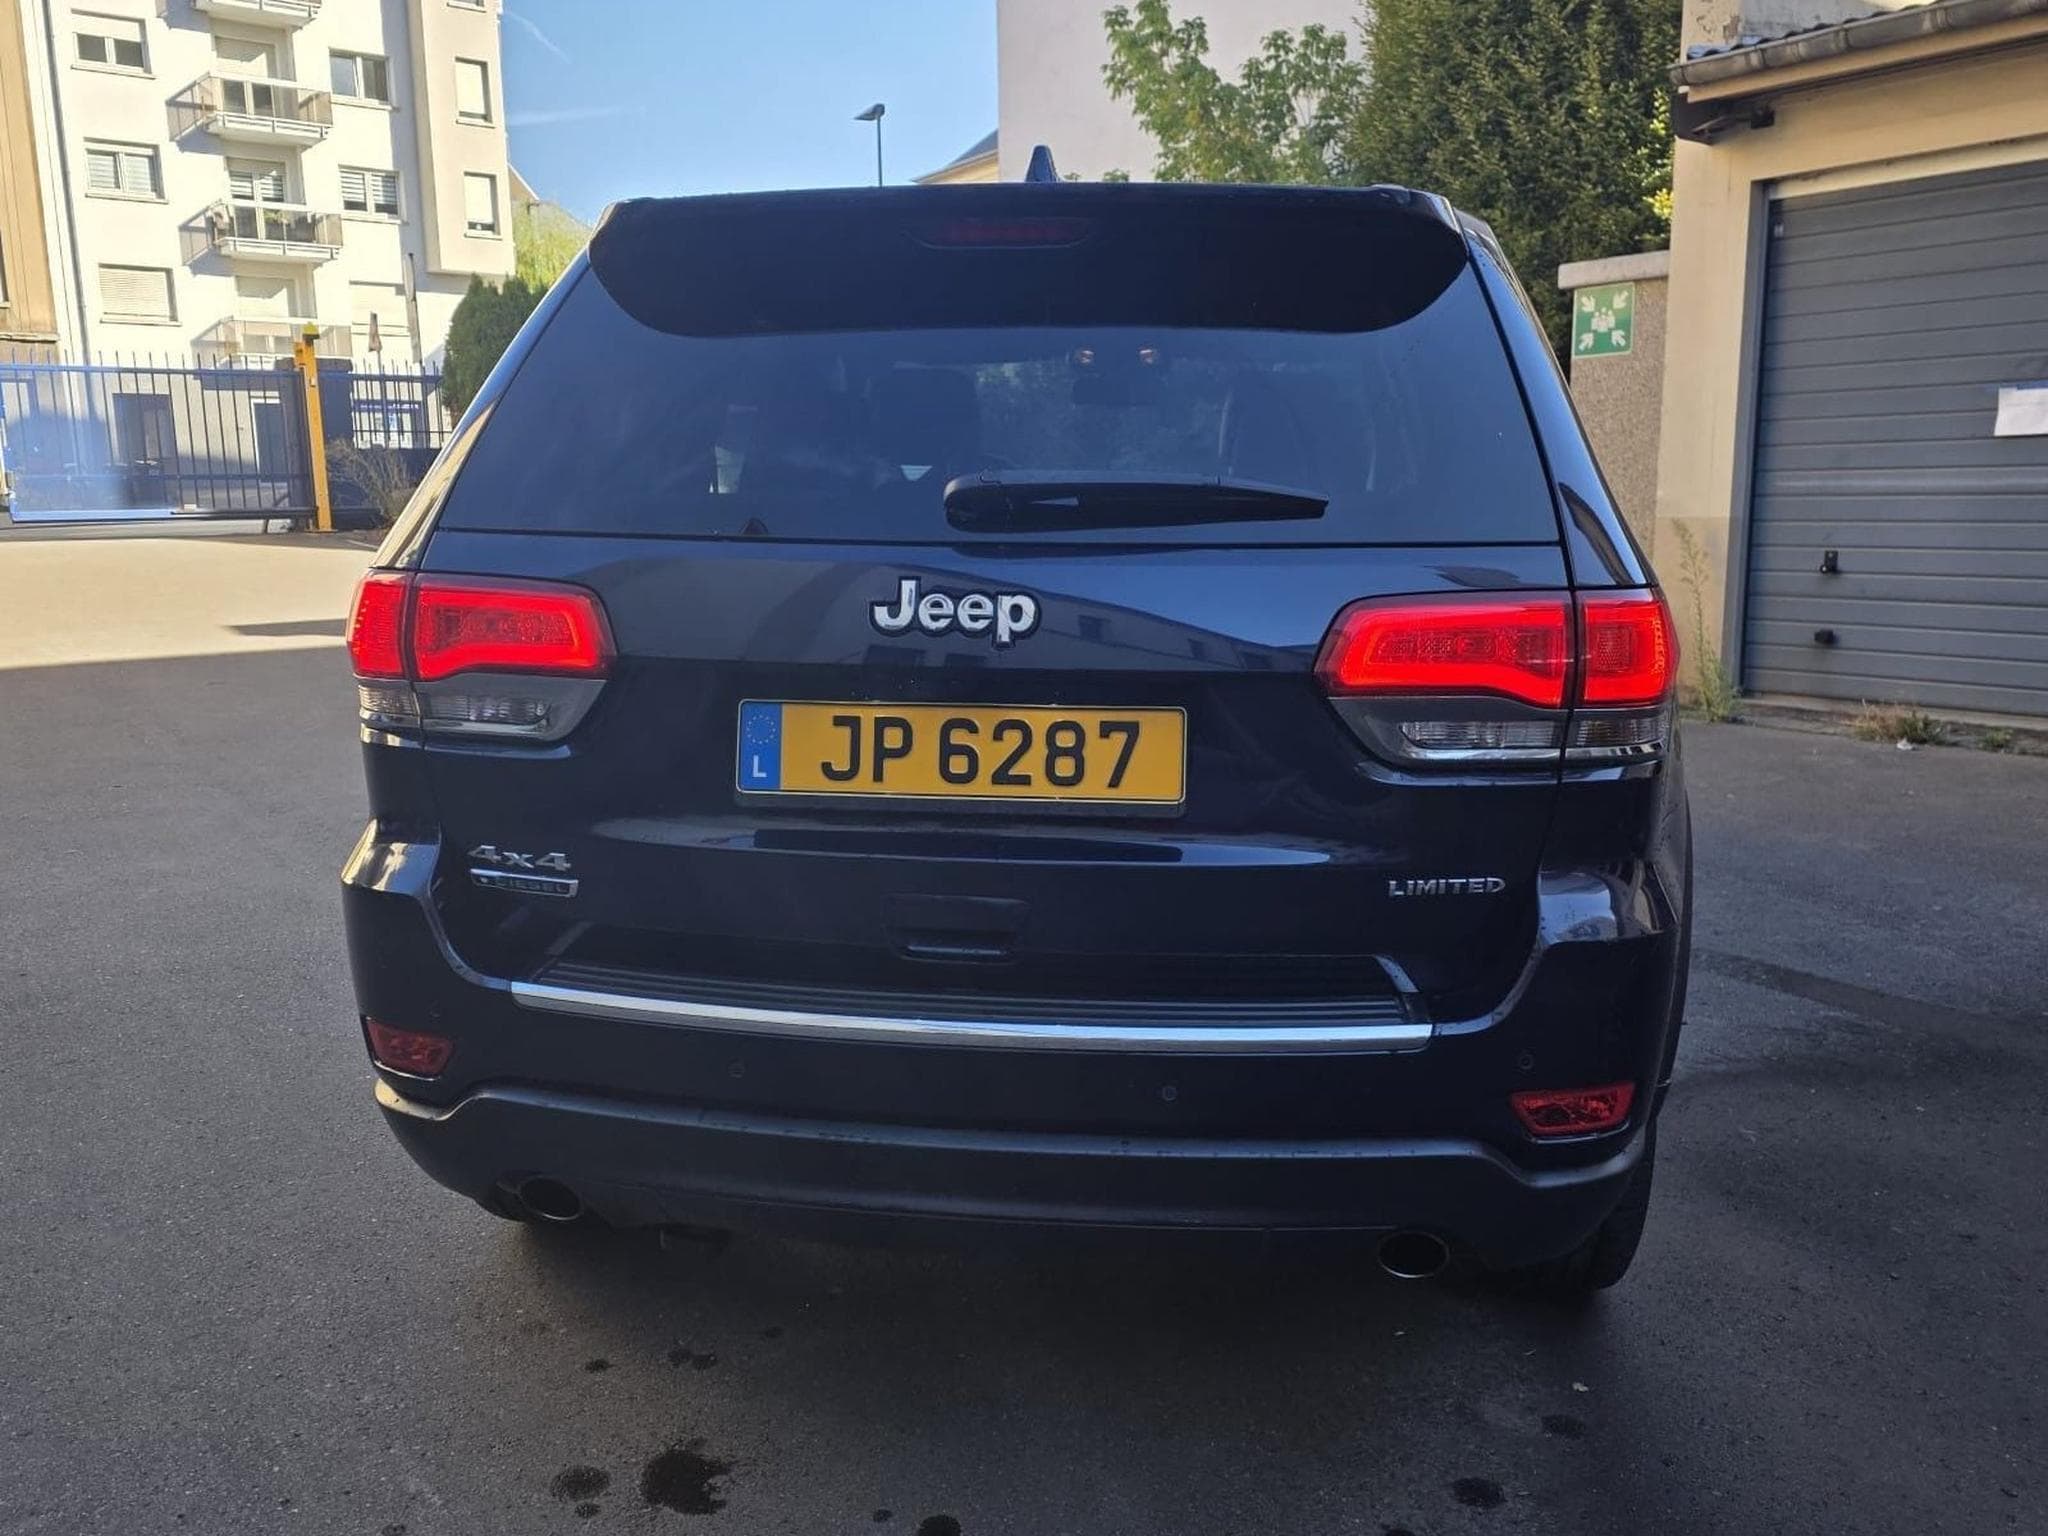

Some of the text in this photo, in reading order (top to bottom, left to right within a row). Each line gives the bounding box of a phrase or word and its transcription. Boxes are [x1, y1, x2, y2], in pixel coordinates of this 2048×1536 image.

[872, 577, 1040, 647] Jeep
[752, 754, 767, 778] L
[821, 714, 1141, 789] JP 6287
[1388, 877, 1506, 897] LIMITED
